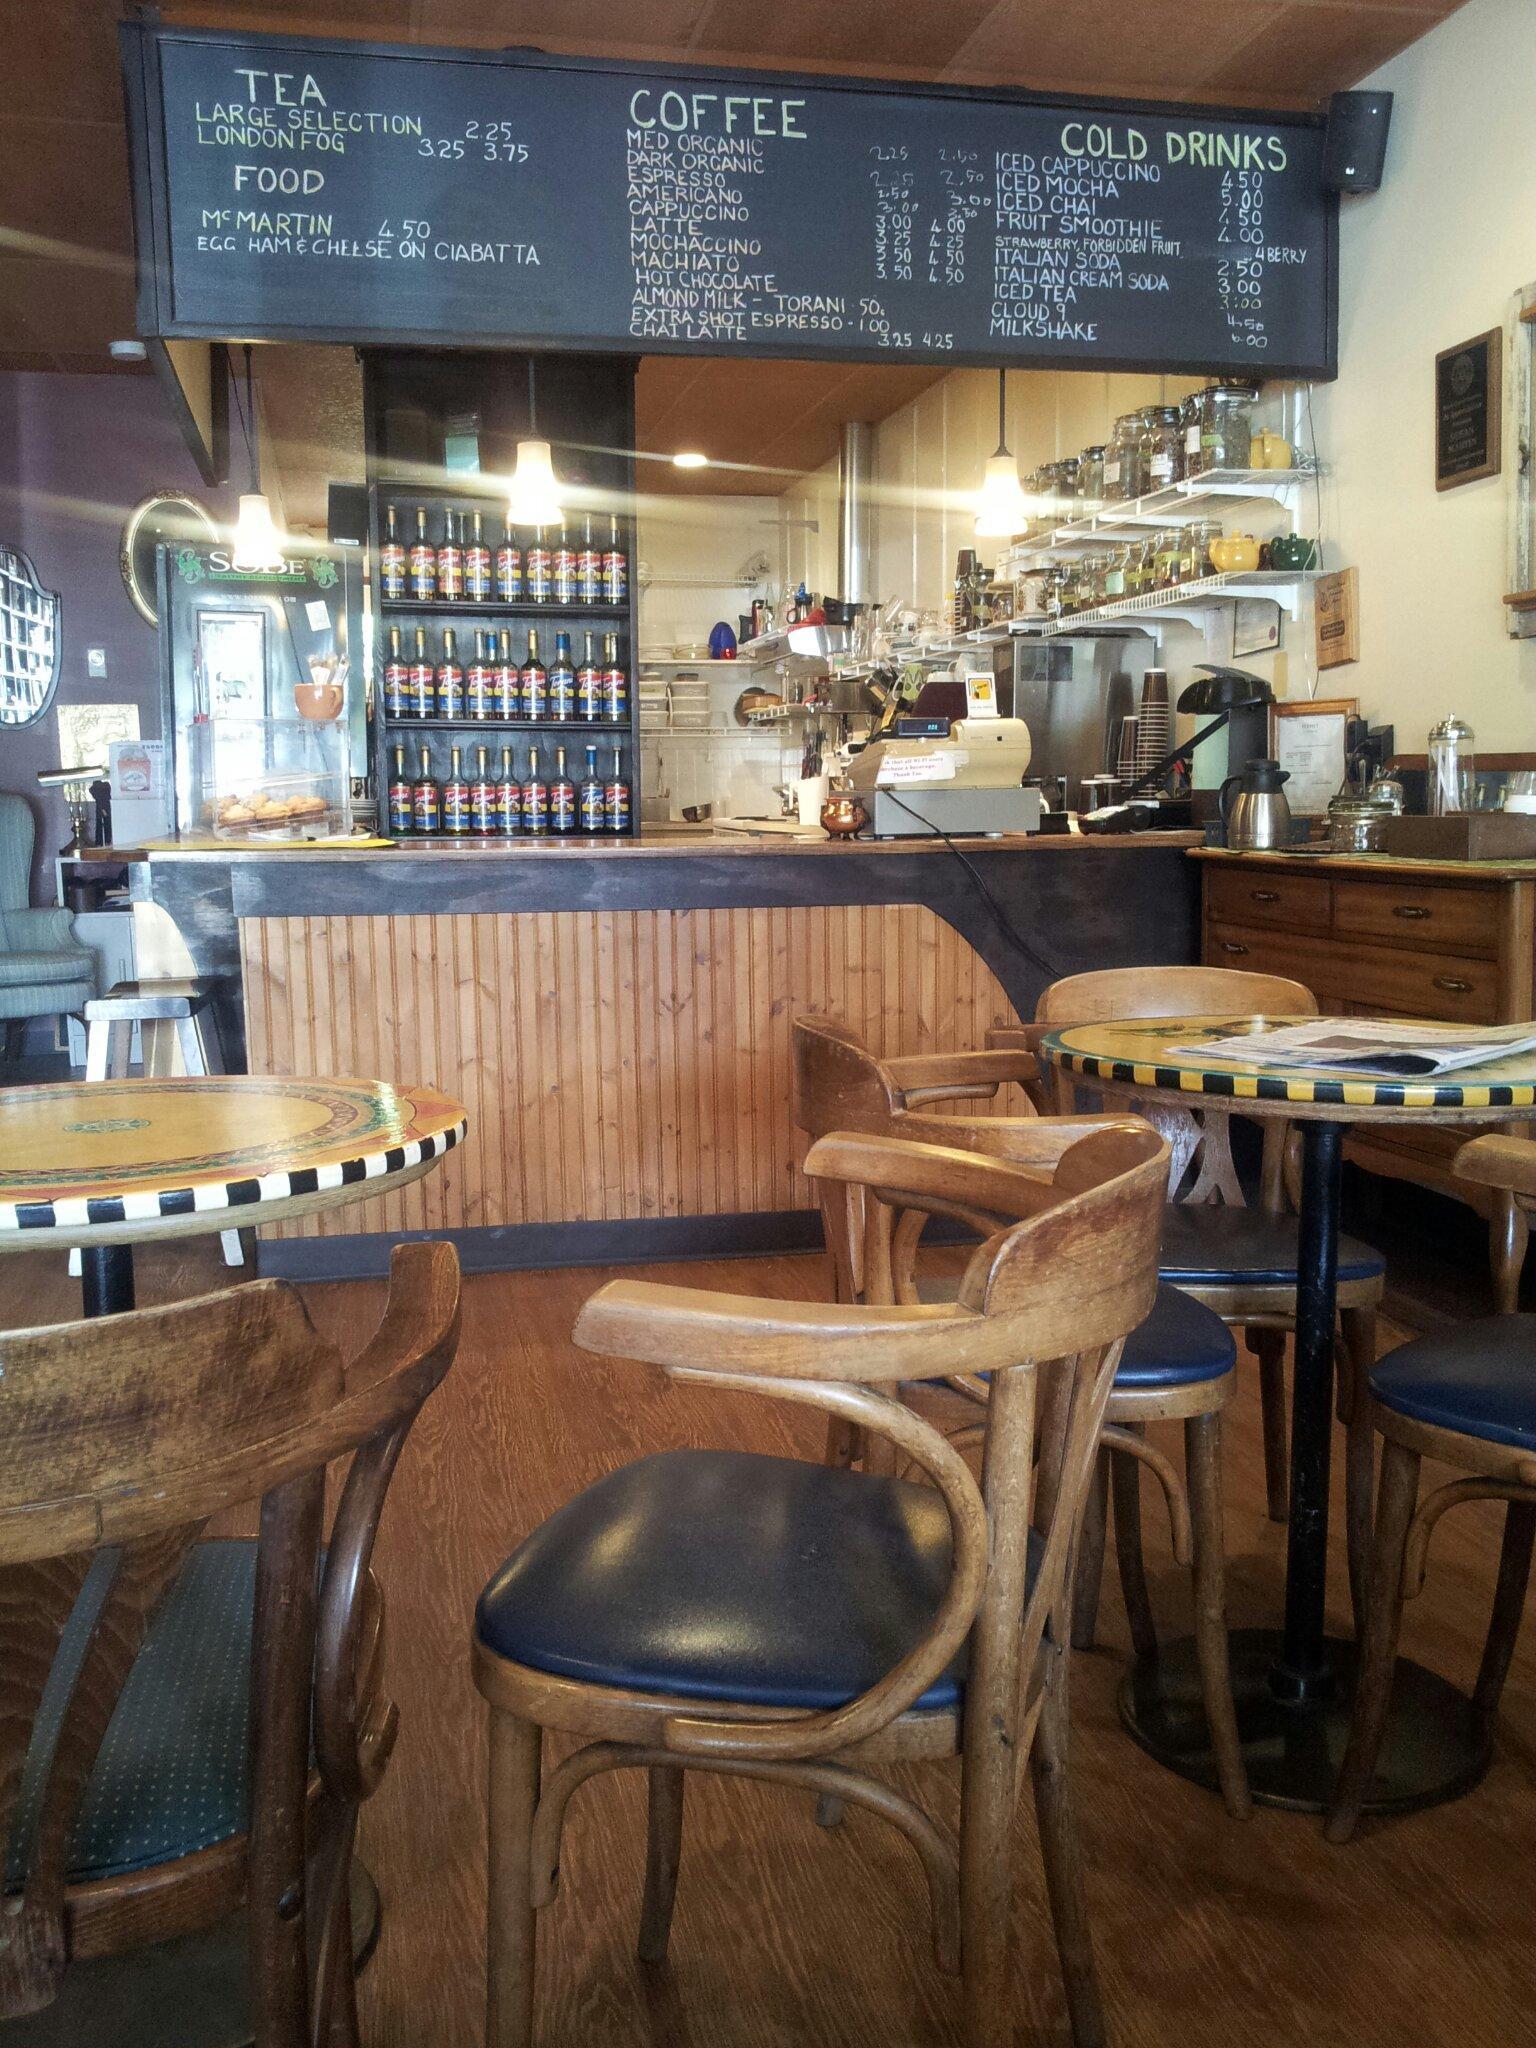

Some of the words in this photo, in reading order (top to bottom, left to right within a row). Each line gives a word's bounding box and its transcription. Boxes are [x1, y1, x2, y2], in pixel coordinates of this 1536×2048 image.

[234, 69, 327, 107] TEA
[196, 102, 277, 129] LARGE
[288, 108, 422, 136] SELECTION
[465, 121, 512, 140] 2.25
[630, 89, 808, 139] COFFEE
[198, 124, 294, 149] LONDON
[301, 131, 344, 154] FOG
[418, 138, 465, 159] 3.25
[484, 142, 529, 162] 3.75
[627, 128, 669, 150] MED
[677, 133, 764, 157] ORGANIC
[1061, 123, 1148, 161] COLD
[1166, 131, 1287, 172] DRINKS
[627, 149, 676, 168] DARK
[682, 153, 765, 175] ORGANIC
[996, 152, 1035, 173] ICED
[1041, 156, 1161, 183] CAPPUCCINO
[1221, 170, 1263, 189] 4.50
[234, 165, 325, 194] FOOD
[628, 166, 726, 188] ESPRESSO
[996, 173, 1040, 193] ICED
[1046, 175, 1119, 198] MOCHA
[1221, 189, 1263, 209] 5.00
[627, 183, 743, 205] AMERICANO
[629, 200, 749, 222] CAPPUCCINO
[875, 213, 912, 230] 3.00
[930, 218, 966, 234] 4.00
[996, 192, 1043, 212] ICED
[1050, 195, 1096, 216] CHAI
[1219, 208, 1262, 226] 4.50
[378, 219, 430, 239] 4.50
[630, 215, 703, 235] LATTE
[875, 229, 911, 246] 3.25
[929, 234, 964, 249] 4.25
[996, 211, 1052, 232] FRUIT
[1059, 216, 1163, 239] SMOOTHIE
[1218, 226, 1264, 244] 4.00
[197, 236, 236, 251] EGG
[249, 237, 291, 254] HAM
[312, 239, 392, 259] CHEESE
[399, 240, 426, 260] ON
[434, 242, 540, 265] CIABATTA
[630, 232, 762, 255] MOCHACCINO
[929, 249, 964, 266] 4.50
[1083, 237, 1146, 254] FORBIDDEN
[631, 251, 739, 273] MACHIATO
[876, 262, 912, 280] 3.50
[929, 267, 964, 283] 4.50
[995, 248, 1068, 268] ITALIAN
[1075, 252, 1121, 270] SODA
[1217, 260, 1262, 277] 2.50
[636, 268, 674, 286] HOT
[679, 271, 778, 293] CHOCOLATE
[994, 266, 1064, 285] ITALIAN
[1069, 271, 1123, 288] CREAM
[1128, 273, 1169, 291] SODA
[1219, 278, 1260, 294] 3.00
[994, 284, 1033, 300] ICED
[1040, 285, 1076, 303] TEA
[632, 286, 699, 308] ALMOND
[704, 290, 747, 309] MILK
[773, 294, 846, 314] TORANI
[991, 302, 1049, 321] CLOUD
[1056, 303, 1066, 321] 9
[631, 306, 694, 325] EXTRA
[698, 310, 745, 326] SHOT
[751, 312, 843, 331] ESPRESSO
[990, 319, 1097, 342] MILKSHAKE
[629, 322, 680, 338] CHAI
[687, 324, 747, 341] LATTE
[878, 332, 912, 348] 3.25
[922, 332, 954, 350] 4.25
